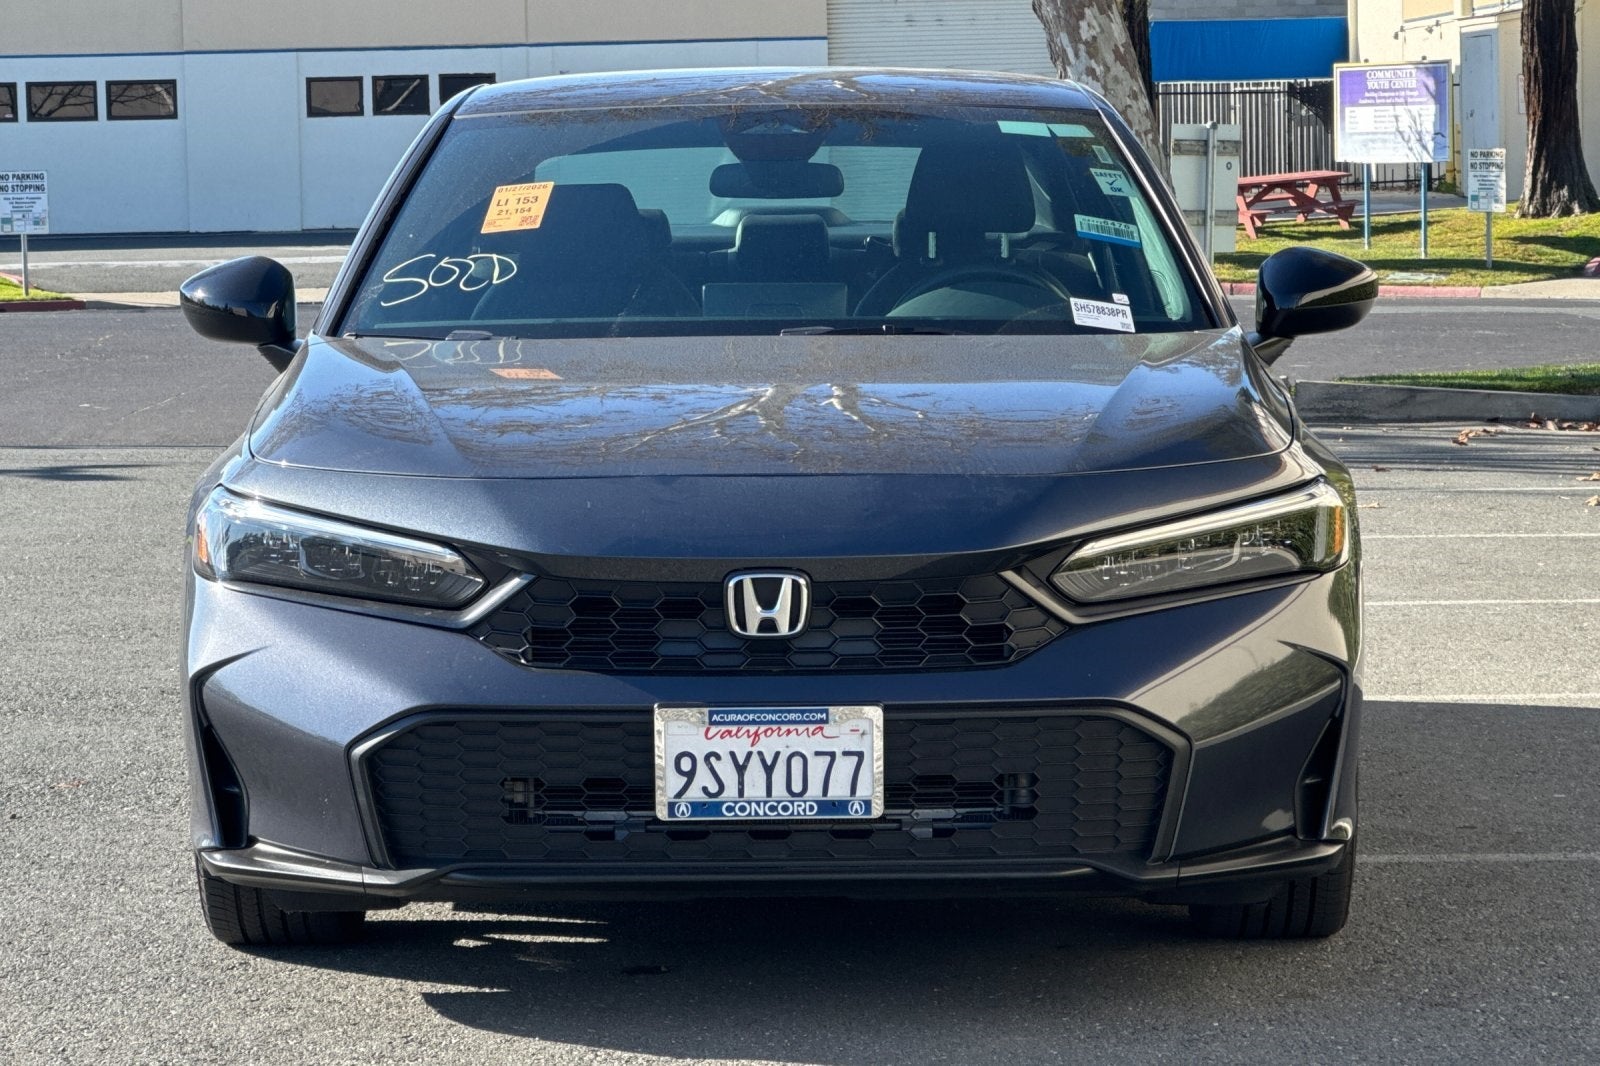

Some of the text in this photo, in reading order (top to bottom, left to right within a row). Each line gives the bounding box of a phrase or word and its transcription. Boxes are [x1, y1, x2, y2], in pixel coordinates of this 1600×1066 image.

[1366, 70, 1417, 79] COMMUNITY
[1366, 79, 1417, 90] YOUTH CENTER
[1470, 162, 1504, 170] NO STOPPING
[1094, 171, 1122, 179] SAFETY
[11, 184, 46, 192] STOPPING
[515, 195, 539, 205] 153
[711, 712, 827, 722] ACURAOFCONCORD.COM
[672, 750, 865, 800] 9SYY077
[721, 801, 818, 816] CONCORD
